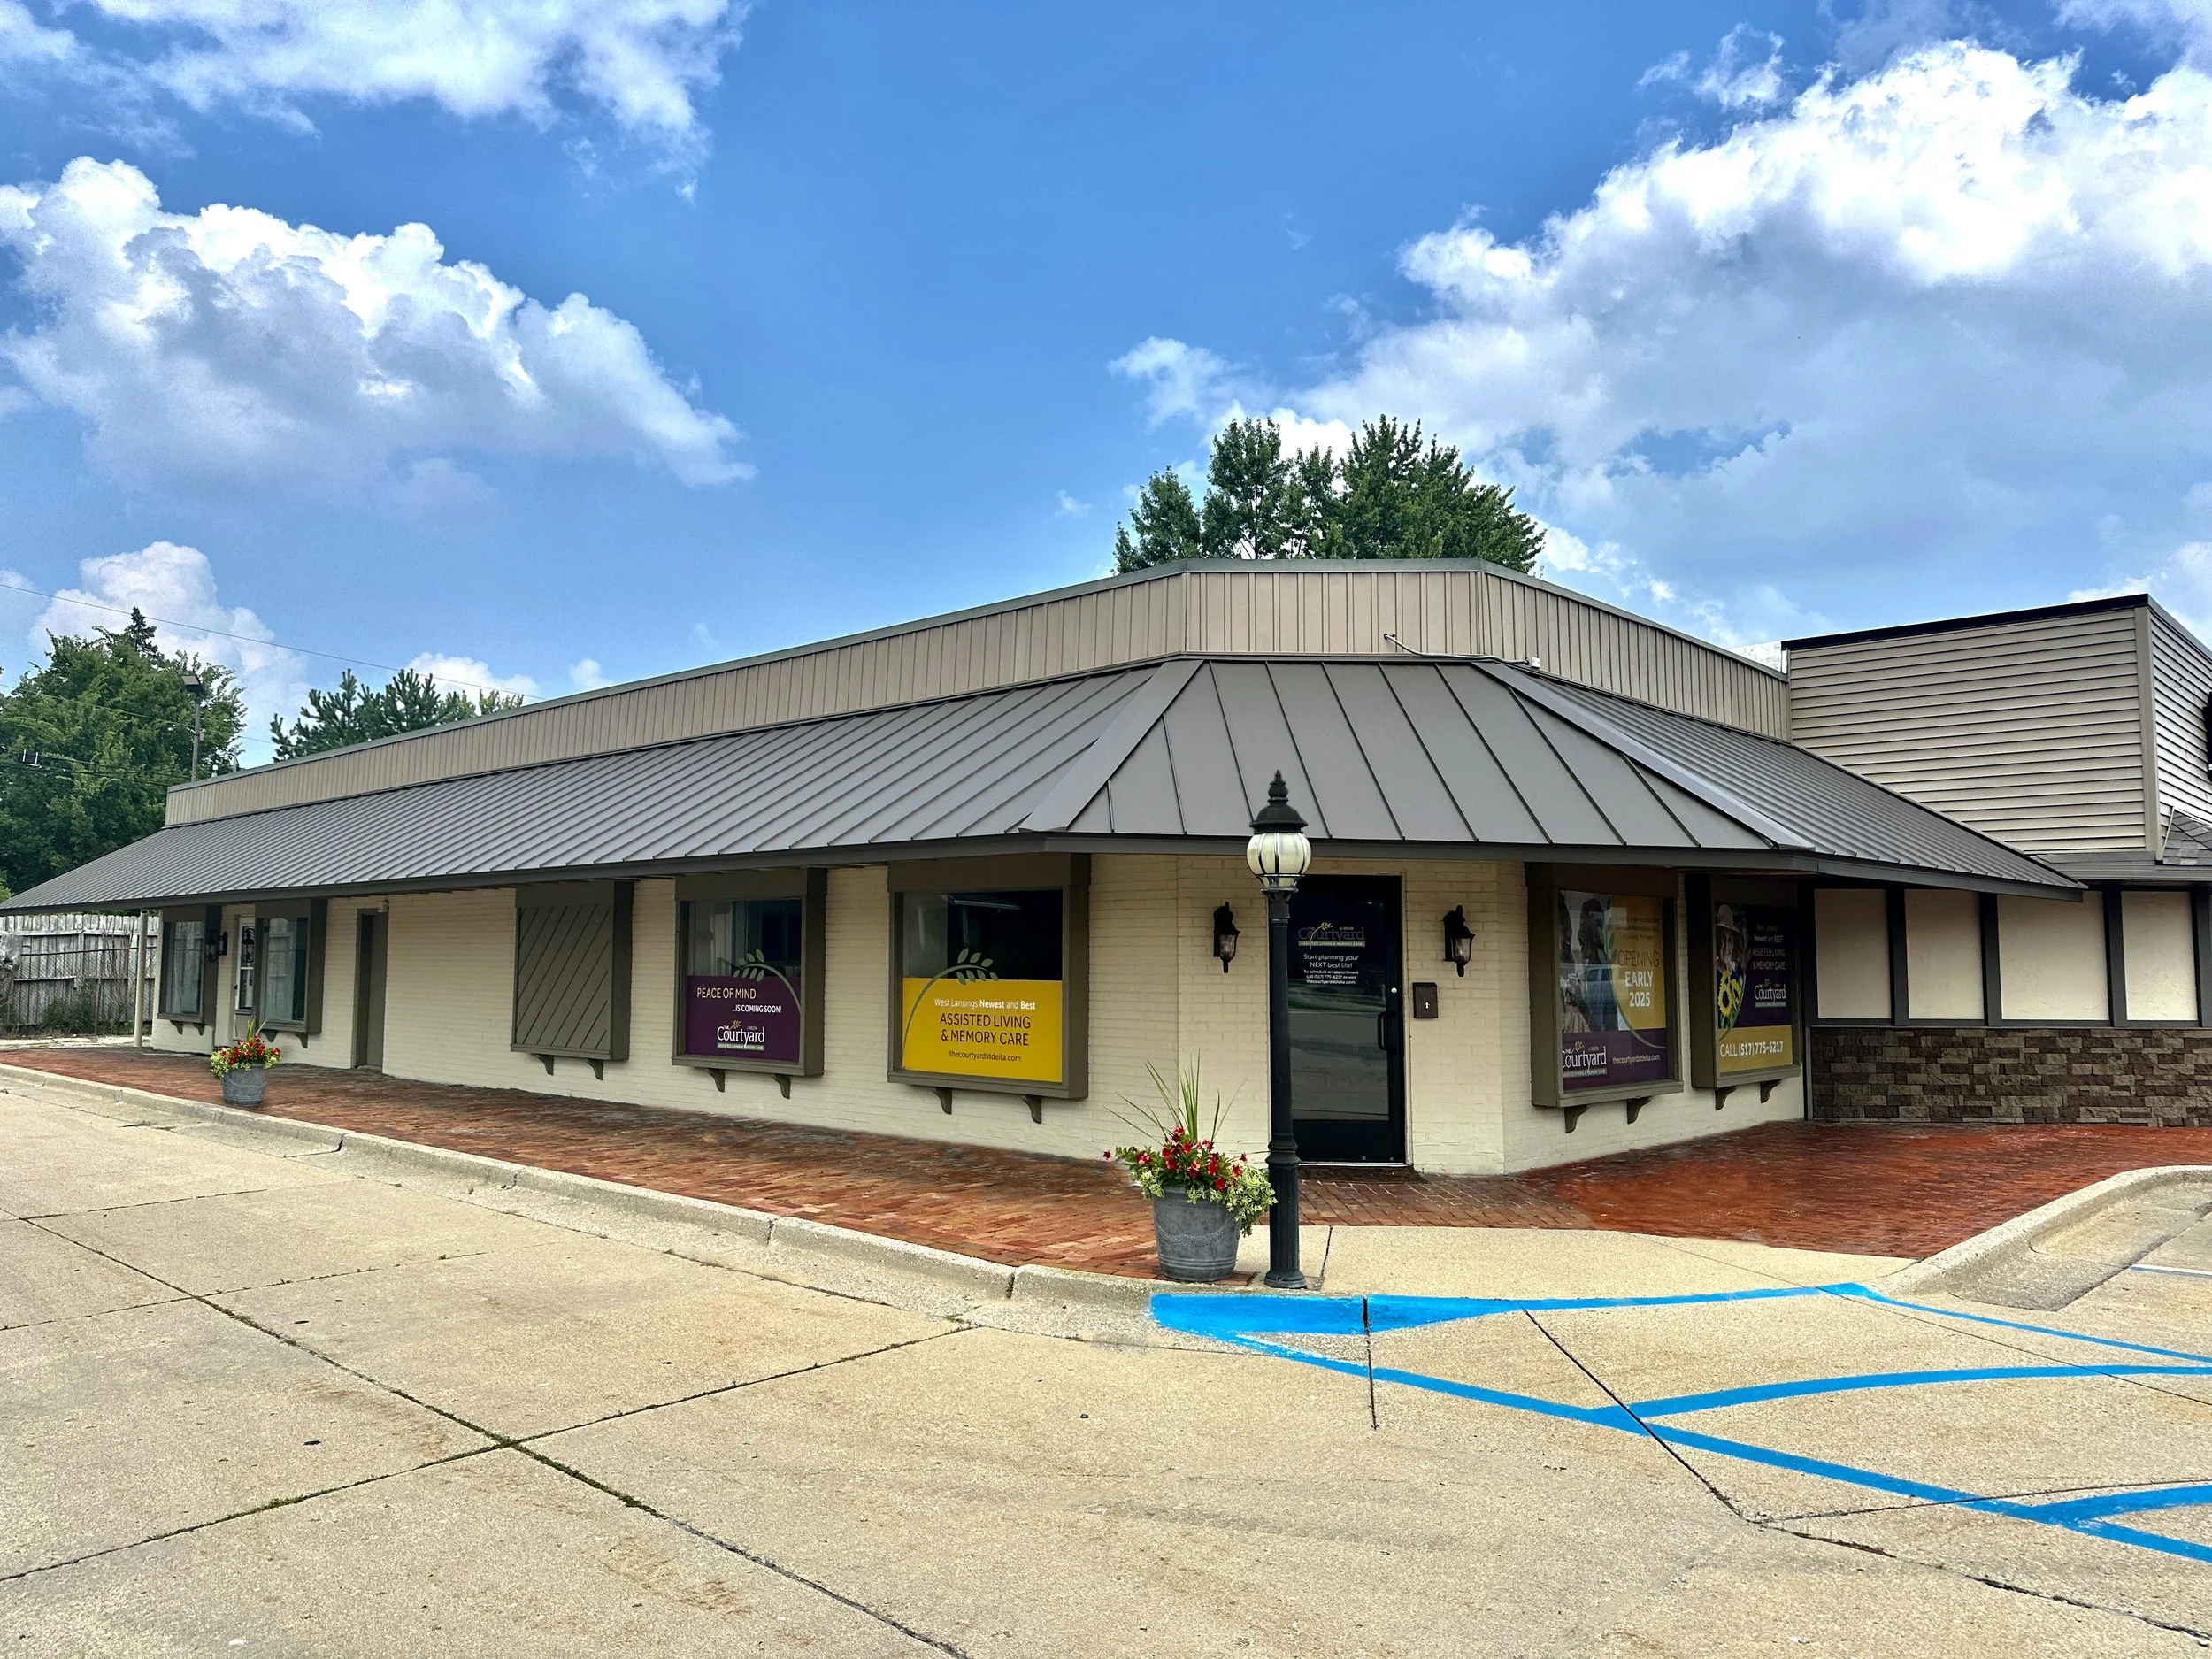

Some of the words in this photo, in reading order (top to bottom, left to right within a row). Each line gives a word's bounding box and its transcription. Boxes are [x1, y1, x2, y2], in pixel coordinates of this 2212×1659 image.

[1298, 926, 1365, 941] Courtyard
[1617, 949, 1660, 967] OPENING
[1752, 948, 1771, 956] ASSISTED
[1775, 961, 1786, 971] CARE
[1625, 971, 1654, 987] EARLY
[696, 987, 721, 999] PEACE
[723, 987, 733, 999] OF
[734, 988, 757, 1000] MIND
[1629, 991, 1651, 1008] 2025
[1755, 983, 1786, 1005] Courtyard
[741, 1004, 764, 1013] COMING
[764, 1005, 782, 1014] SOON!
[934, 998, 949, 1007] West
[951, 998, 978, 1010] Lansings
[979, 999, 1004, 1009] Newest
[1006, 1001, 1019, 1010] and
[1020, 1001, 1036, 1010] Best
[940, 1012, 991, 1027] ASSISTED
[994, 1014, 1031, 1029] LIVING
[717, 1025, 765, 1048] Courtyard
[941, 1028, 949, 1041] &
[950, 1029, 997, 1044] MEMORY
[999, 1032, 1029, 1046] CARE
[949, 1050, 1021, 1063] thecourtyardatdelta.com
[1719, 1042, 1738, 1058] CALL
[1738, 1041, 1755, 1057] (517)
[1755, 1040, 1784, 1056] 775-6217
